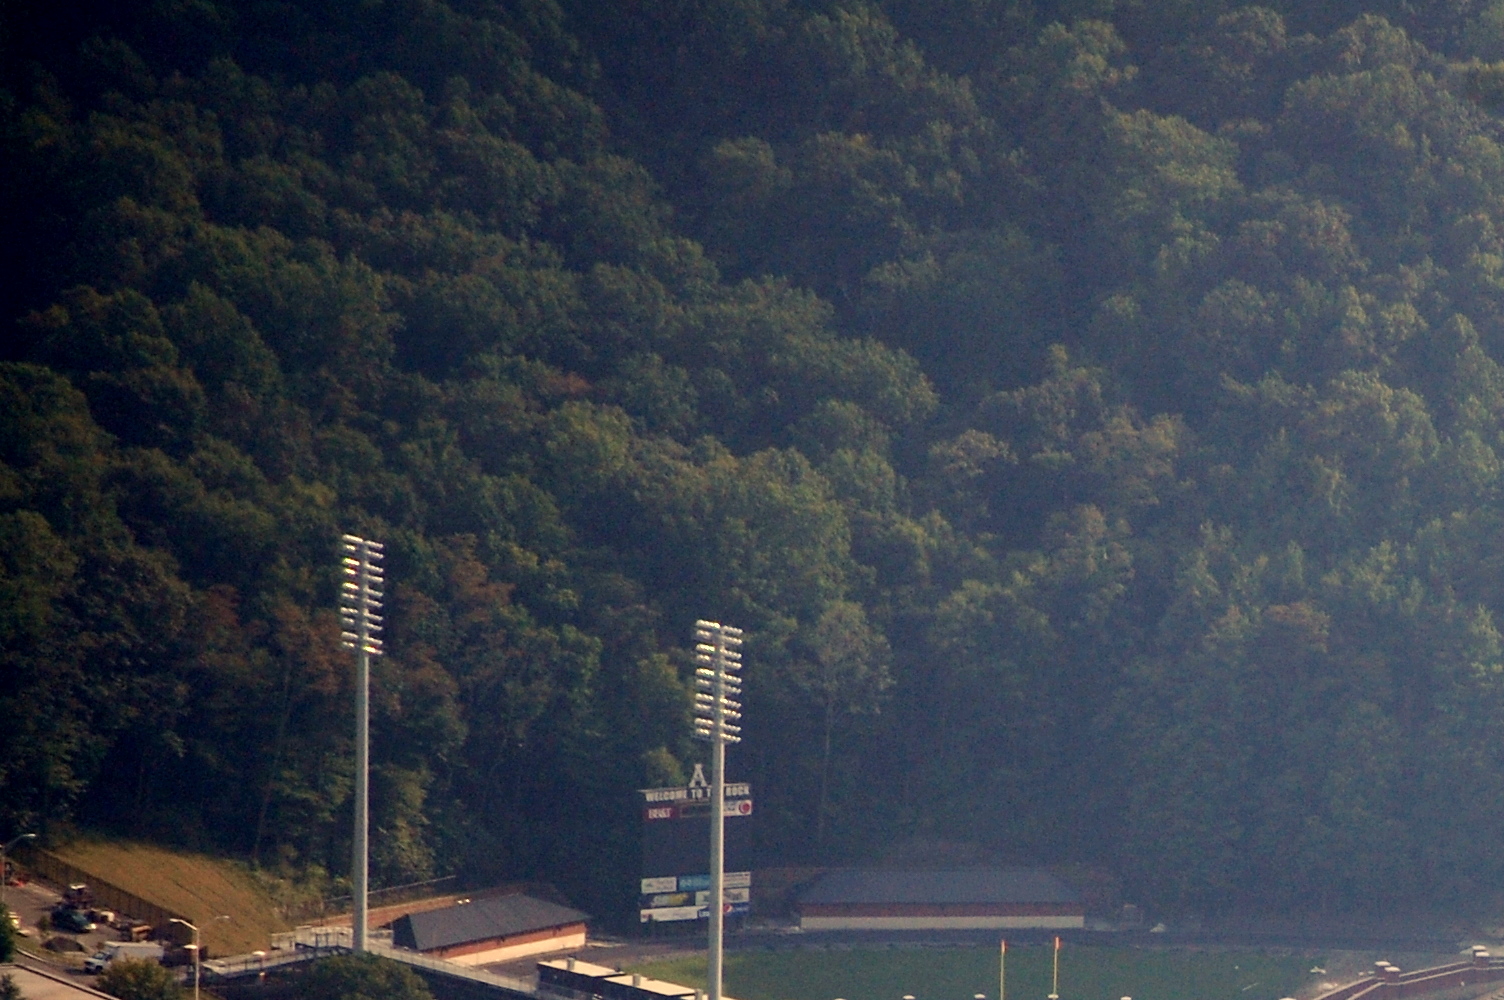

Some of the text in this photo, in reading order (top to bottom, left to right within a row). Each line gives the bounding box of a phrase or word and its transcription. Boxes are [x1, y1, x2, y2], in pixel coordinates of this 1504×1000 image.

[689, 763, 708, 788] A
[645, 790, 687, 801] WELCOME
[691, 788, 703, 799] TO
